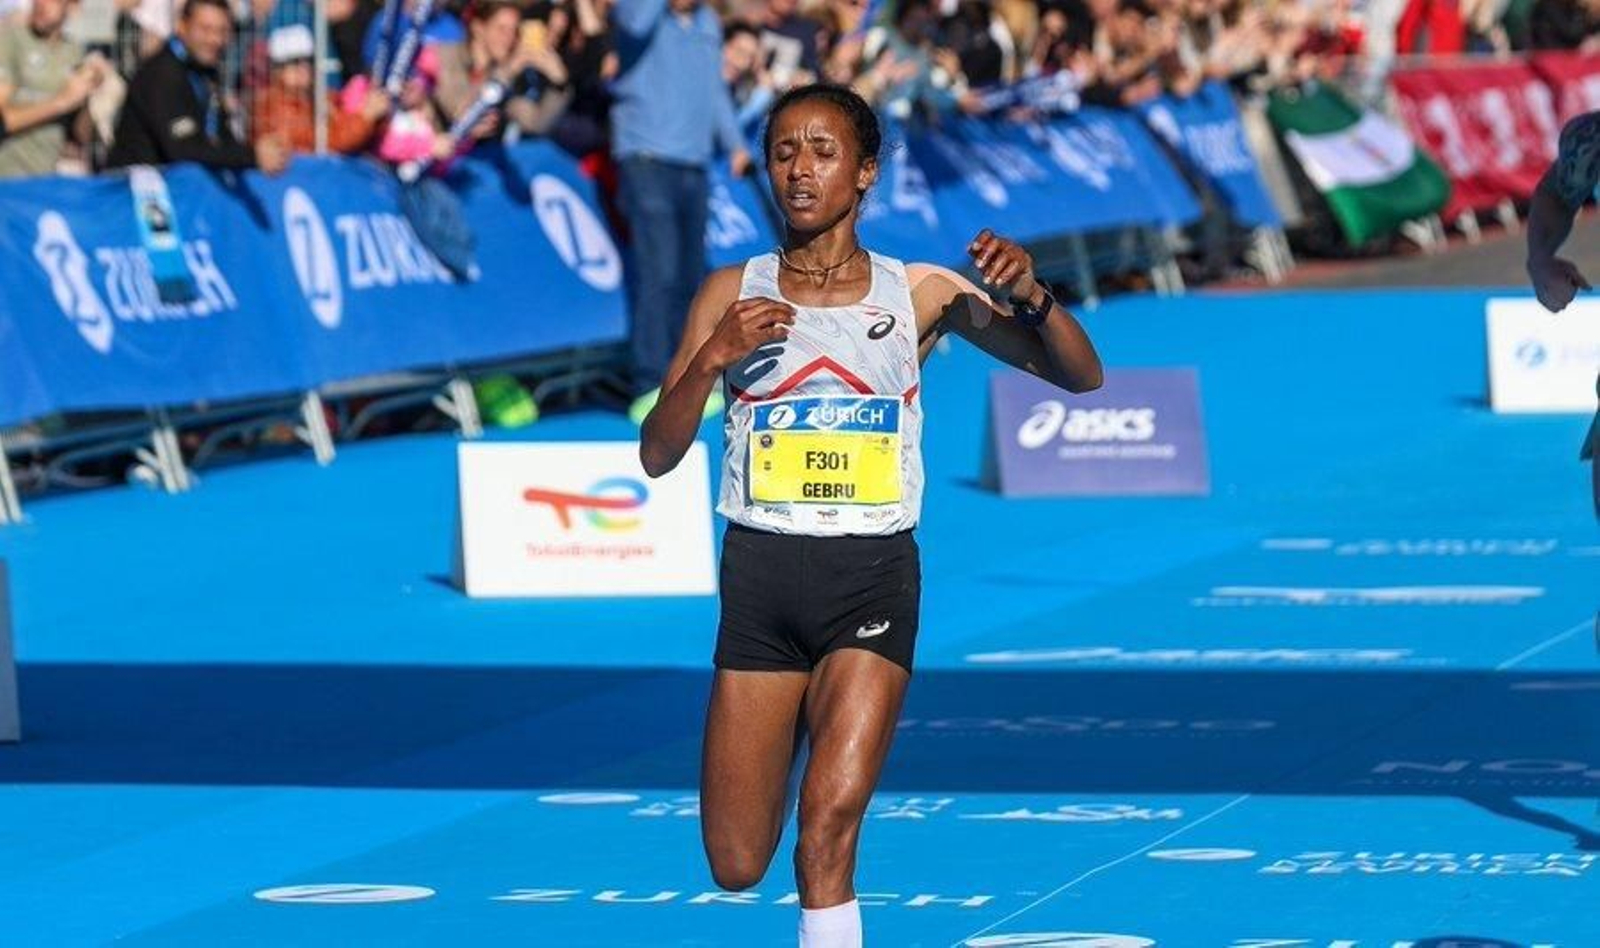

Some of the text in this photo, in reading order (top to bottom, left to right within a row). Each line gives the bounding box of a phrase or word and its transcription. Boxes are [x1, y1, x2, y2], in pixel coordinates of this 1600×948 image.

[804, 405, 884, 425] ZURICH
[1061, 407, 1156, 442] asics
[805, 451, 849, 471] F301
[802, 483, 856, 499] GEBRU
